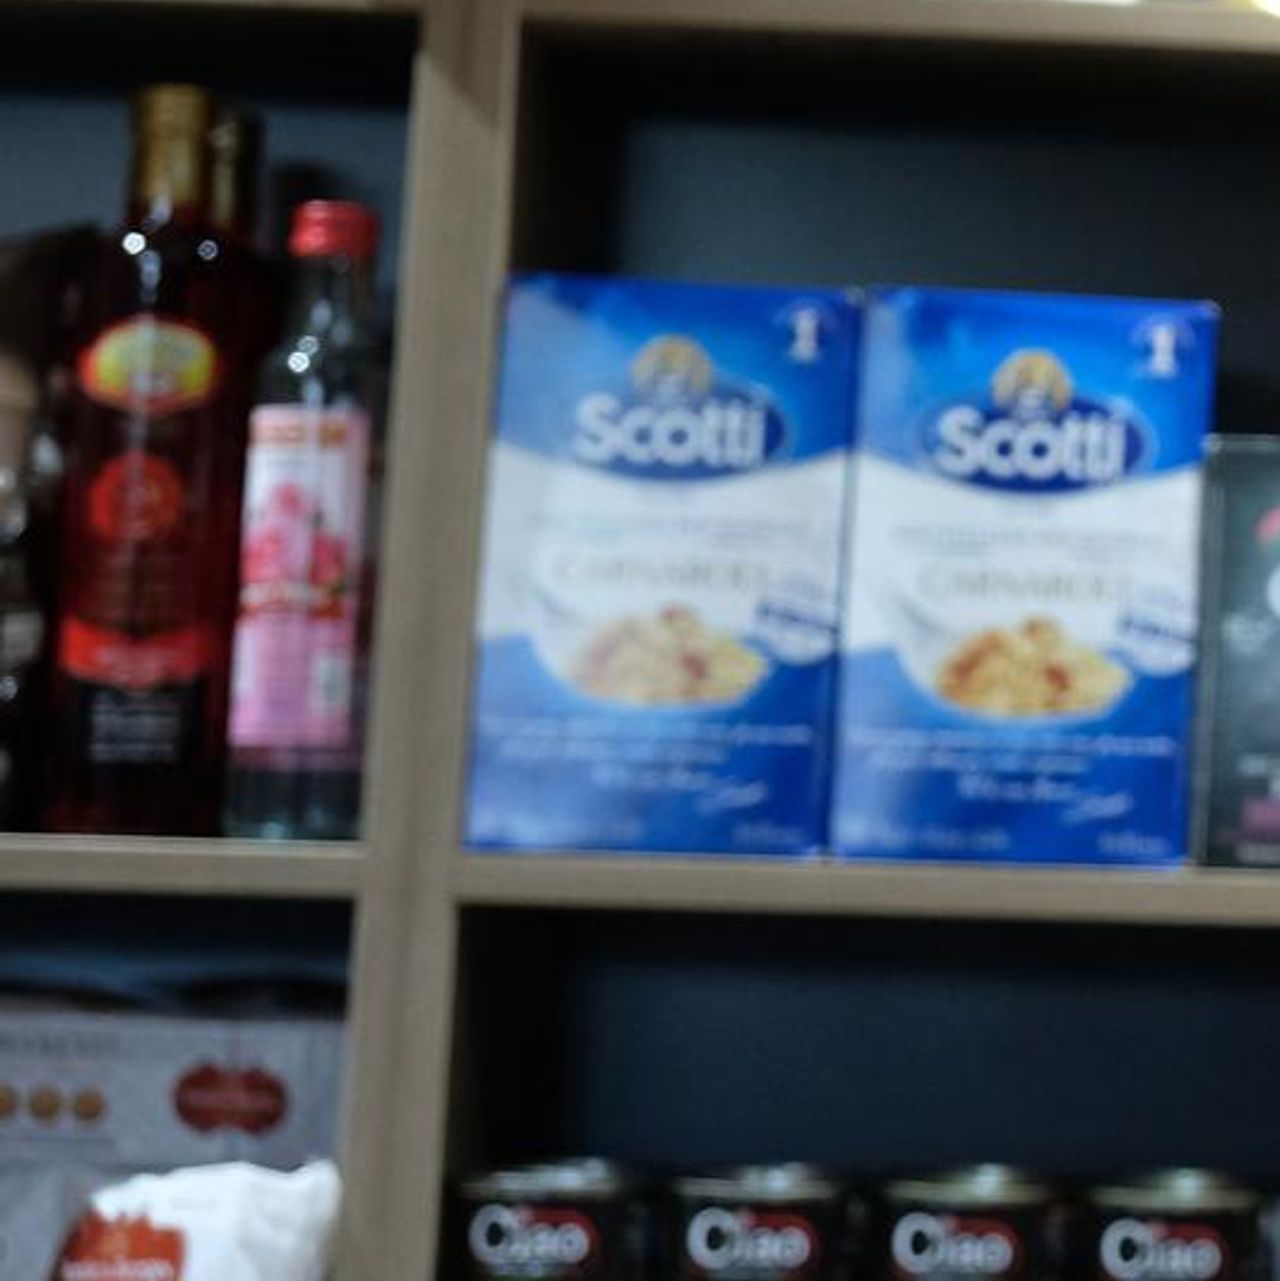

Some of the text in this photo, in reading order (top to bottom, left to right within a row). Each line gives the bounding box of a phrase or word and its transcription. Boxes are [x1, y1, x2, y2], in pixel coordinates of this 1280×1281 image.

[1148, 325, 1179, 378] 1
[574, 392, 765, 468] Scotti
[937, 406, 1125, 481] Scotti
[469, 1204, 588, 1263] Ciao
[688, 1207, 810, 1269] Ciao
[892, 1212, 1013, 1274] Ciao
[1101, 1218, 1222, 1279] Ciao
